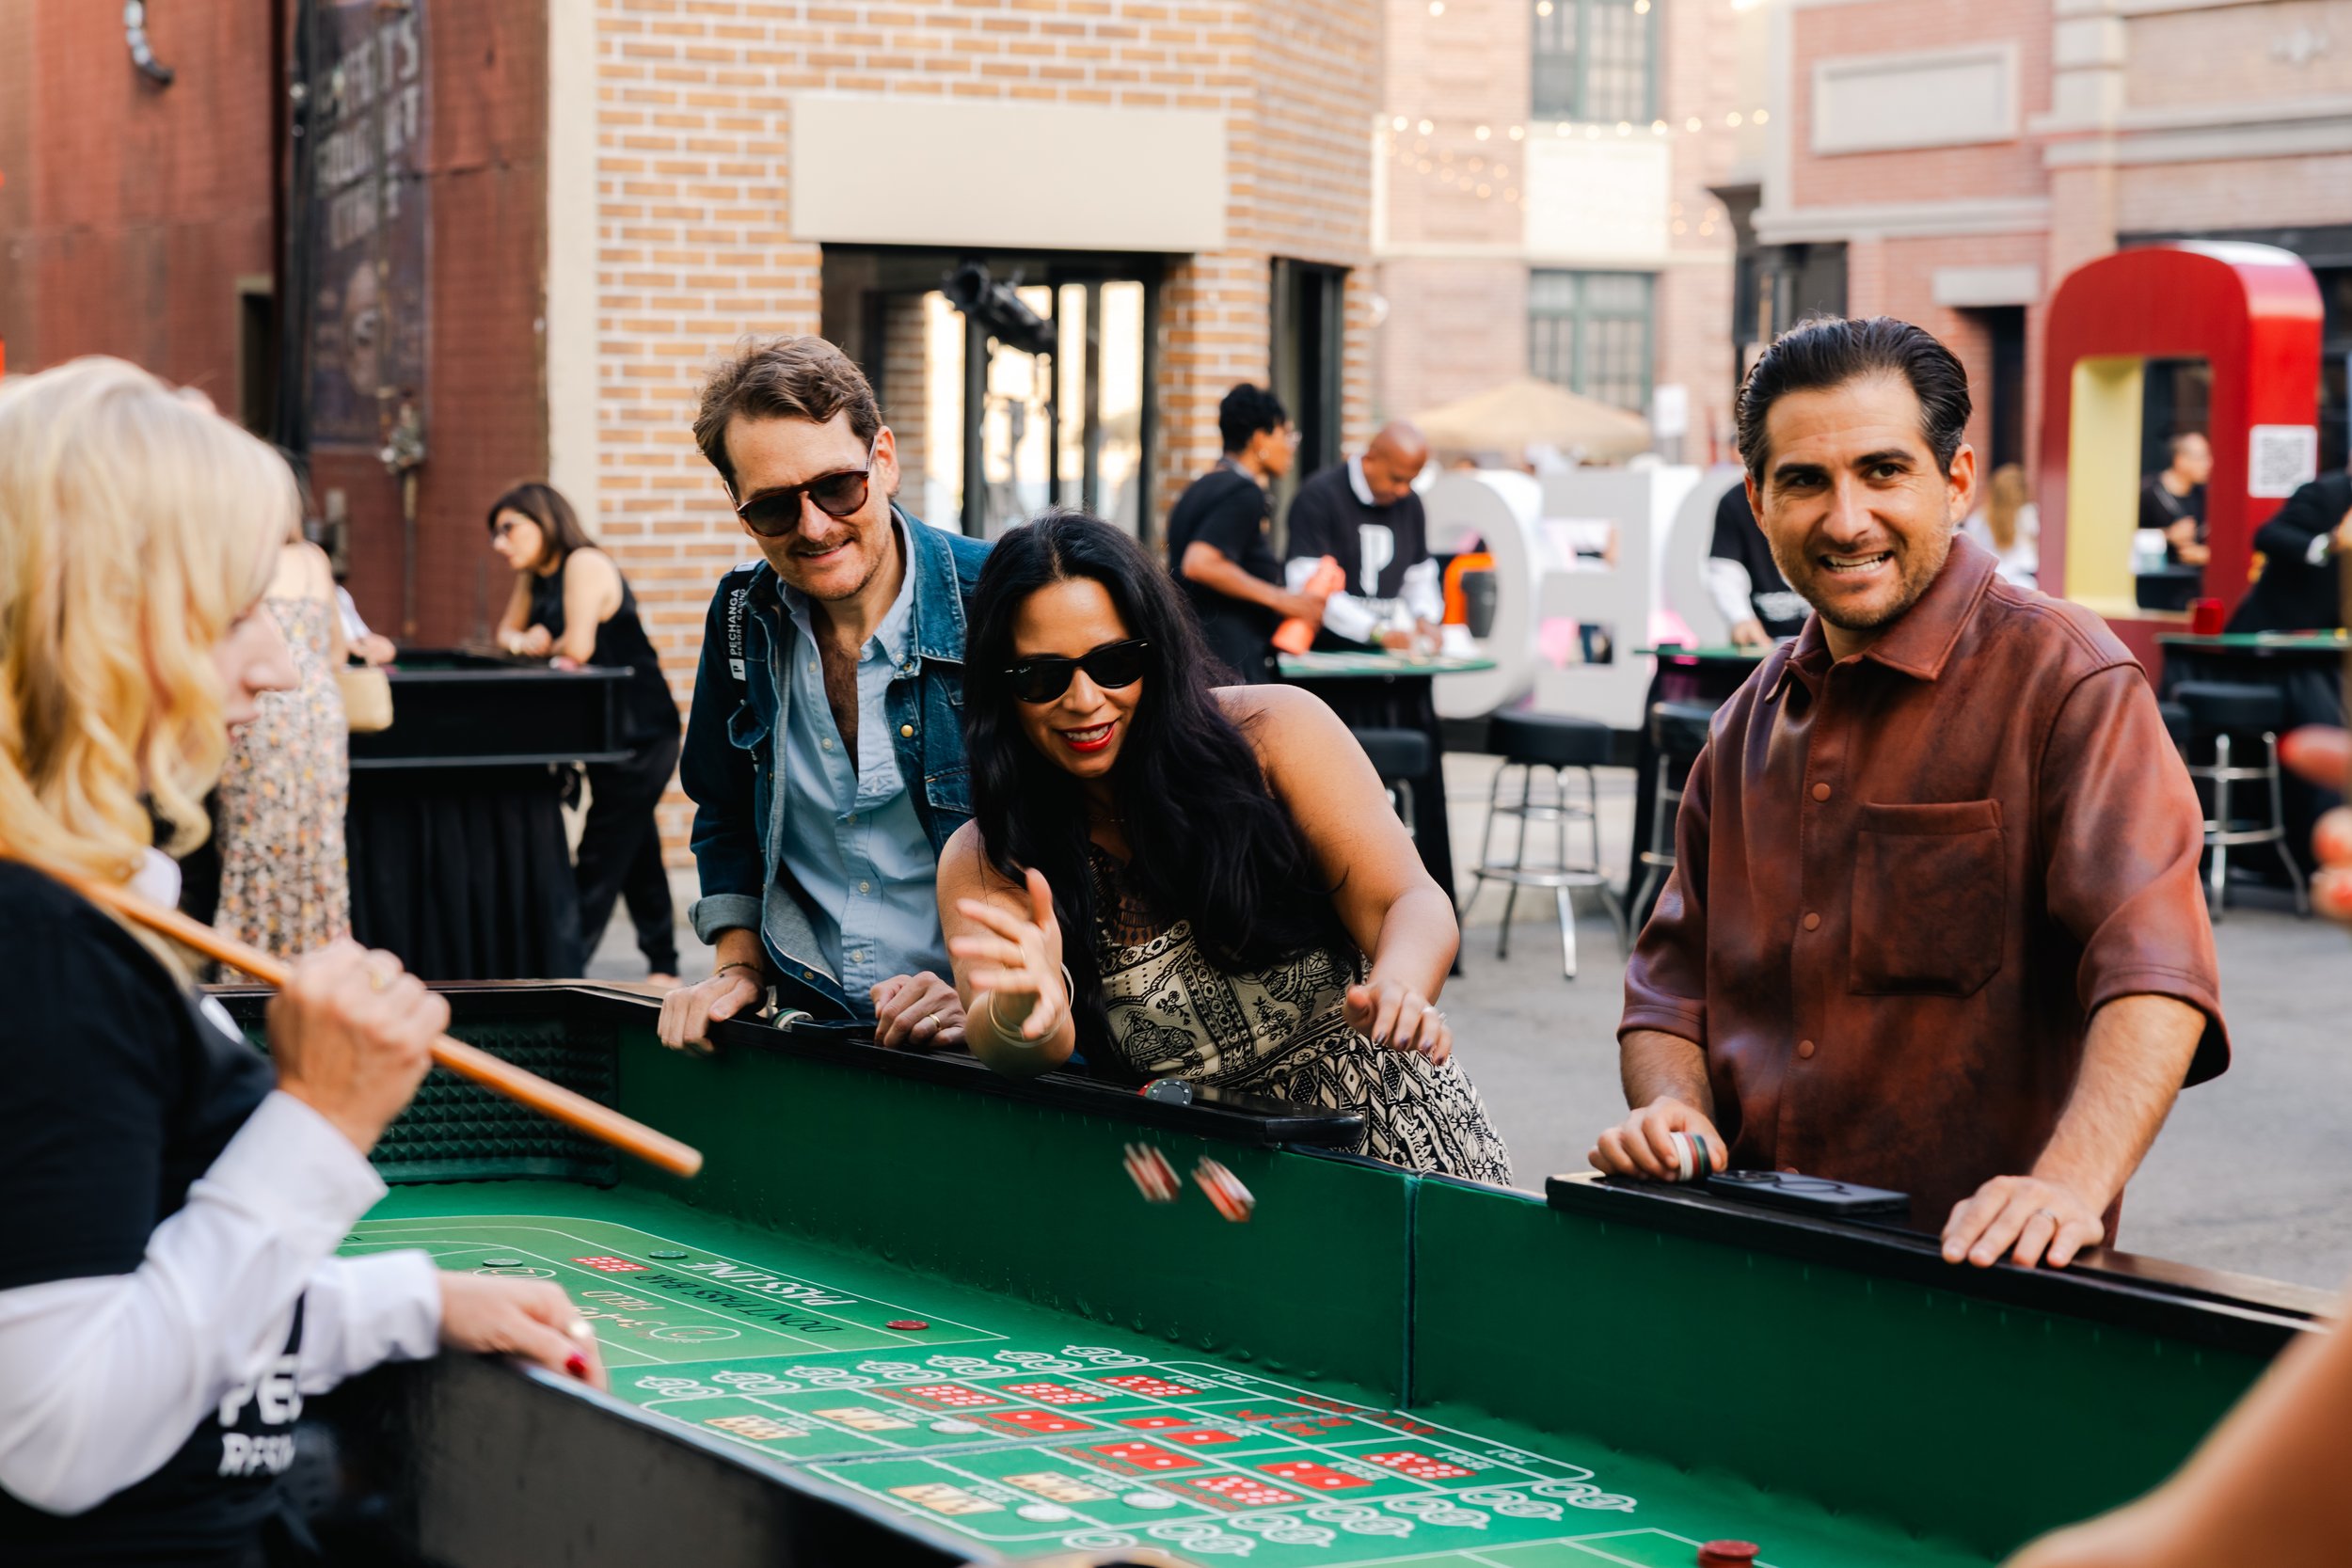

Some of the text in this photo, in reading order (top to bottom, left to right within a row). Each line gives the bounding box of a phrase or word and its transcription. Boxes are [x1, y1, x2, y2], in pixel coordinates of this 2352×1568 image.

[1359, 523, 1394, 596] P
[727, 589, 740, 656] PECHANGA
[580, 1291, 666, 1311] FIELD
[634, 1274, 701, 1290] BAR
[677, 1260, 858, 1307] PASS LINE
